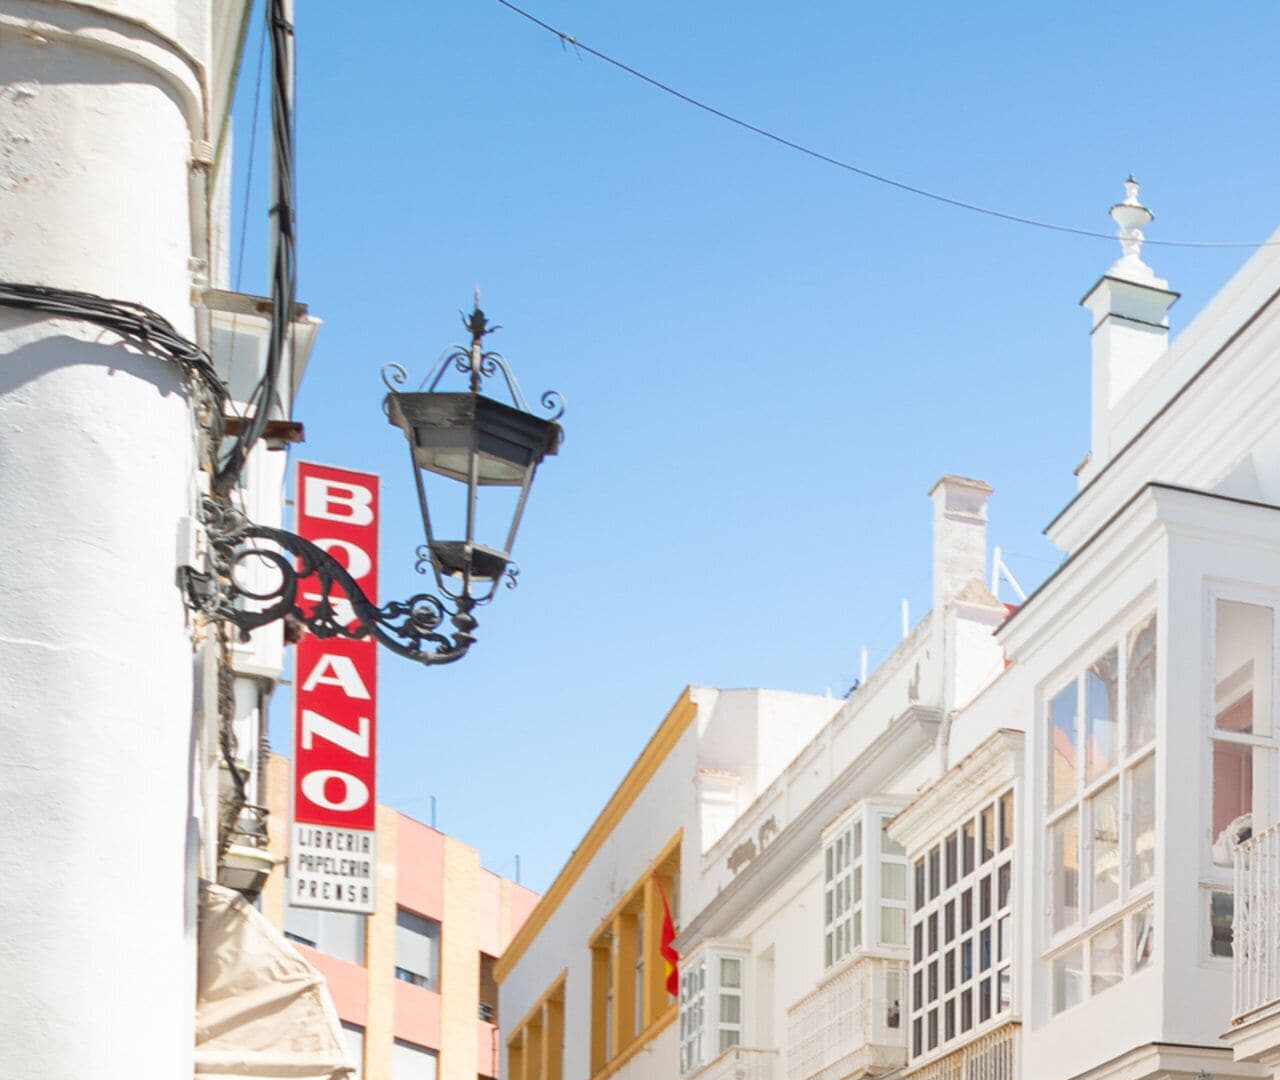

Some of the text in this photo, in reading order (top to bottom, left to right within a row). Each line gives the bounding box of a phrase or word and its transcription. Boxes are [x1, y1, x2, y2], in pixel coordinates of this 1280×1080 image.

[299, 827, 370, 853] LIBRERIA
[298, 854, 370, 878] PAPELERIA
[297, 879, 369, 903] PRENSA
